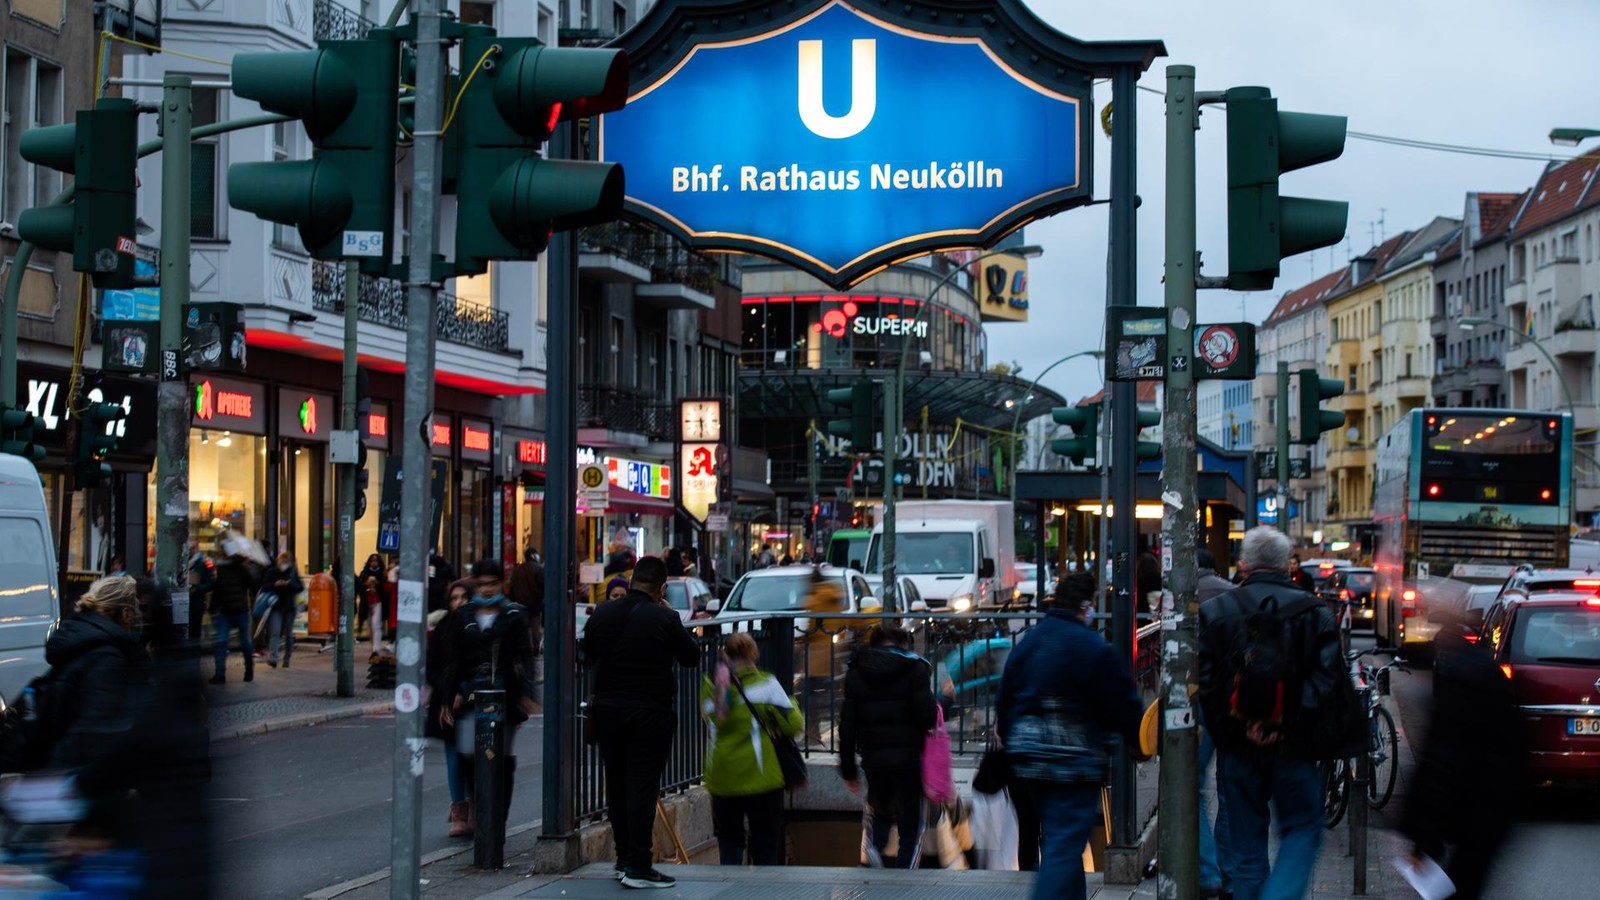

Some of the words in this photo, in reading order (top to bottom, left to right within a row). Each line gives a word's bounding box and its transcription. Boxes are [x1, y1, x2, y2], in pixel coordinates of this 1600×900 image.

[798, 38, 877, 139] U
[672, 164, 729, 193] Bhf.
[740, 163, 860, 191] Rathaus
[870, 161, 1004, 190] Neukölln
[346, 233, 381, 251] BSG
[1575, 720, 1583, 732] B
